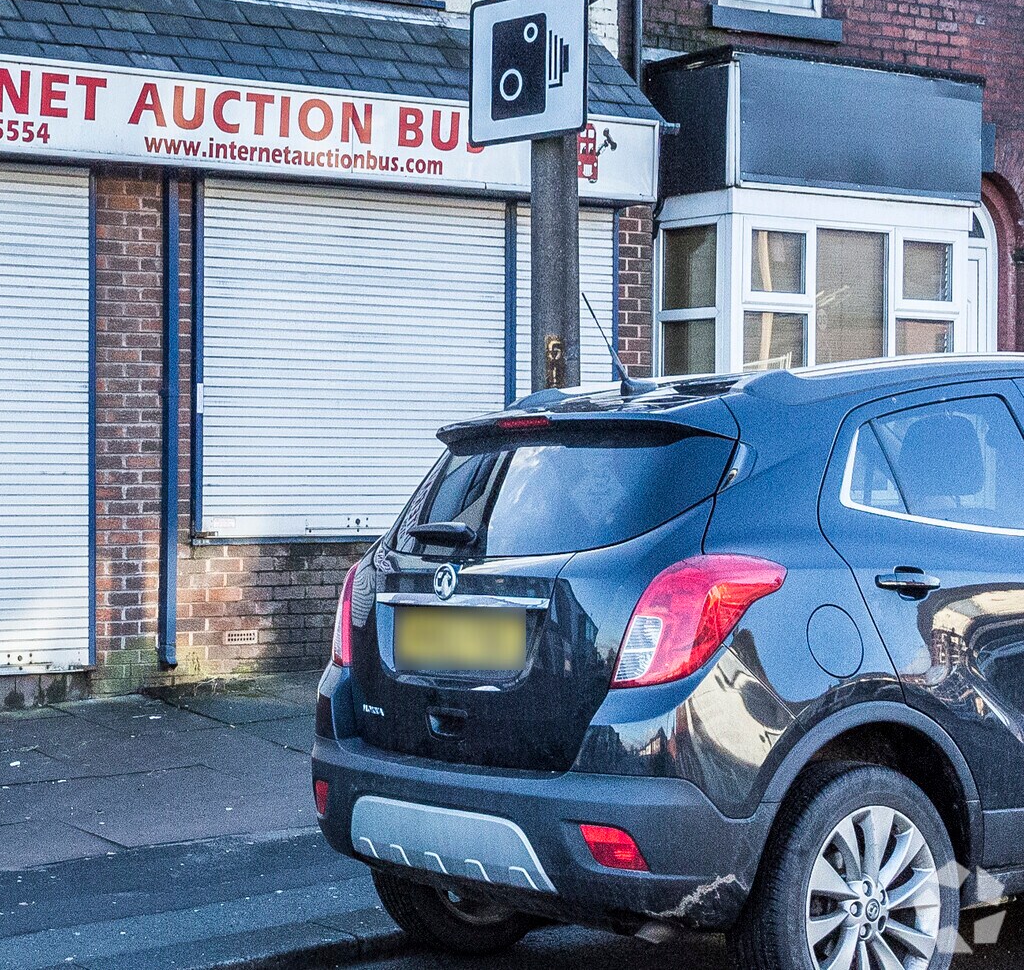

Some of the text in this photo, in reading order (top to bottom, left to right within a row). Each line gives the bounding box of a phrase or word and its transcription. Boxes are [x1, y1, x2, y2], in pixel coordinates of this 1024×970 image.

[129, 83, 374, 145] AUCTION
[398, 107, 486, 155] BU
[144, 136, 444, 176] www.internetauctionbus.com
